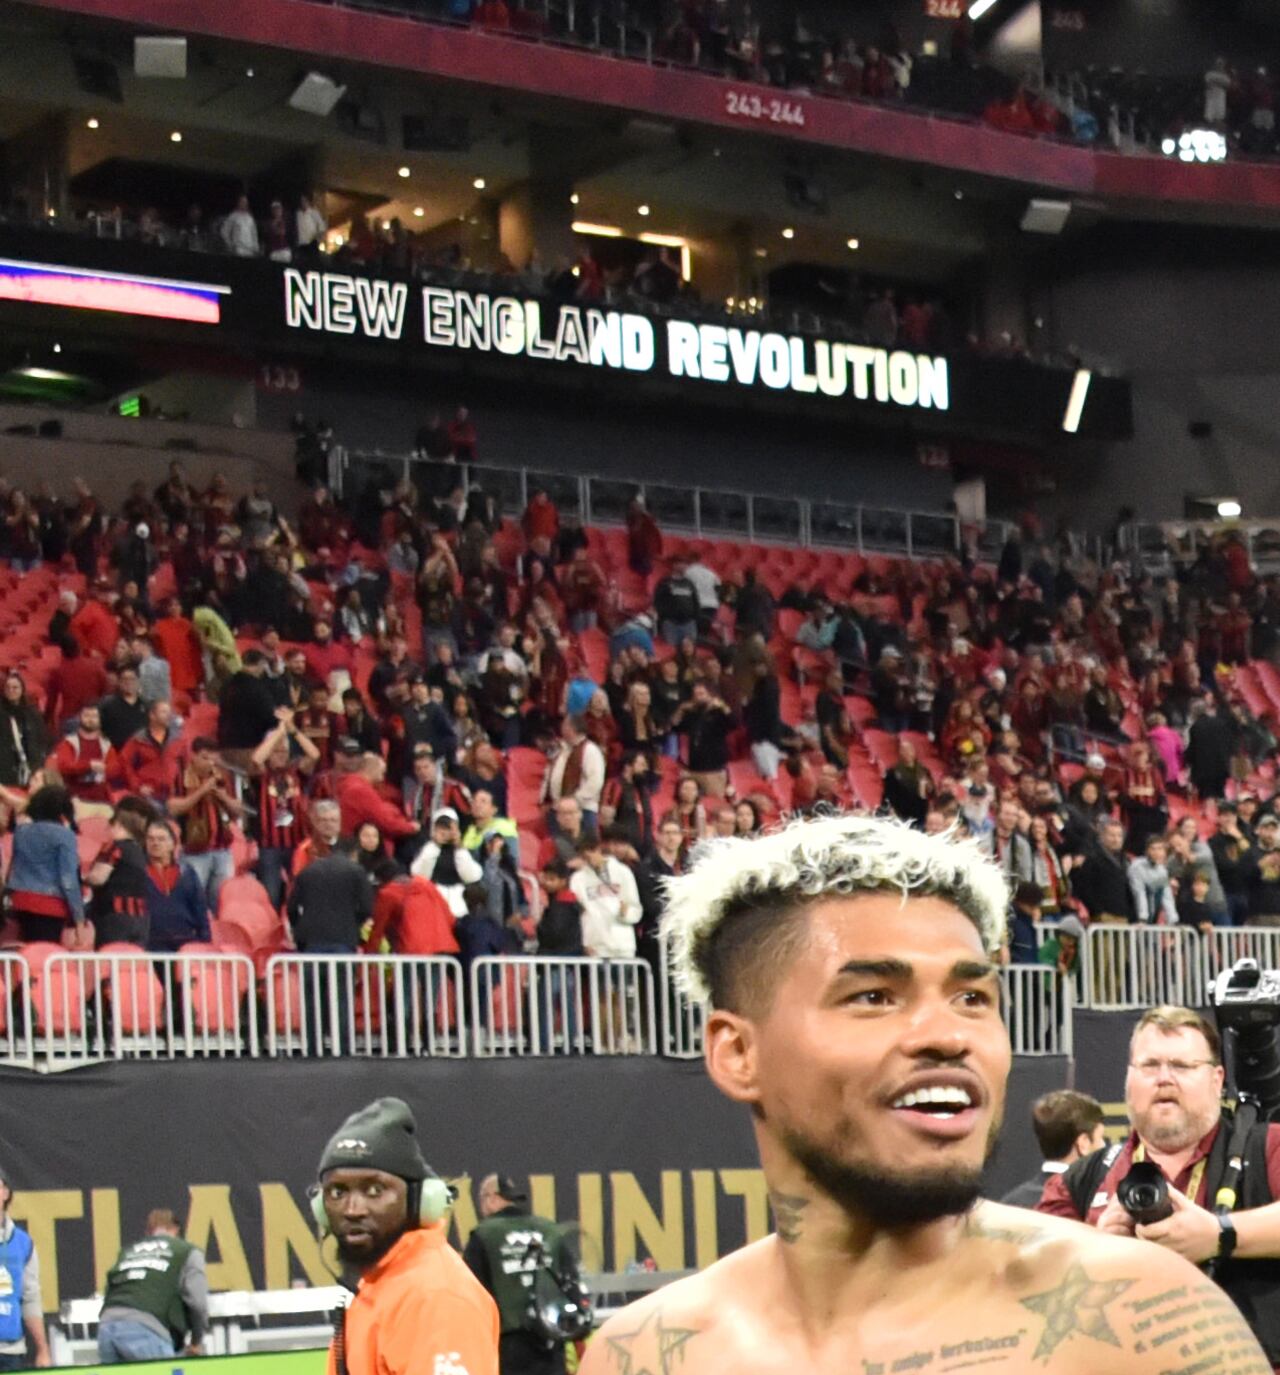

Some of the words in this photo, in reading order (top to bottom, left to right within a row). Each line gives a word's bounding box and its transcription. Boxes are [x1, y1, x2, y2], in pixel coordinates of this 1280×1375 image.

[726, 92, 804, 125] 243-244
[284, 268, 407, 340] NEW
[422, 286, 655, 371] ENGLAND
[667, 319, 949, 411] REVOLUTION
[529, 1168, 772, 1275] UNIT
